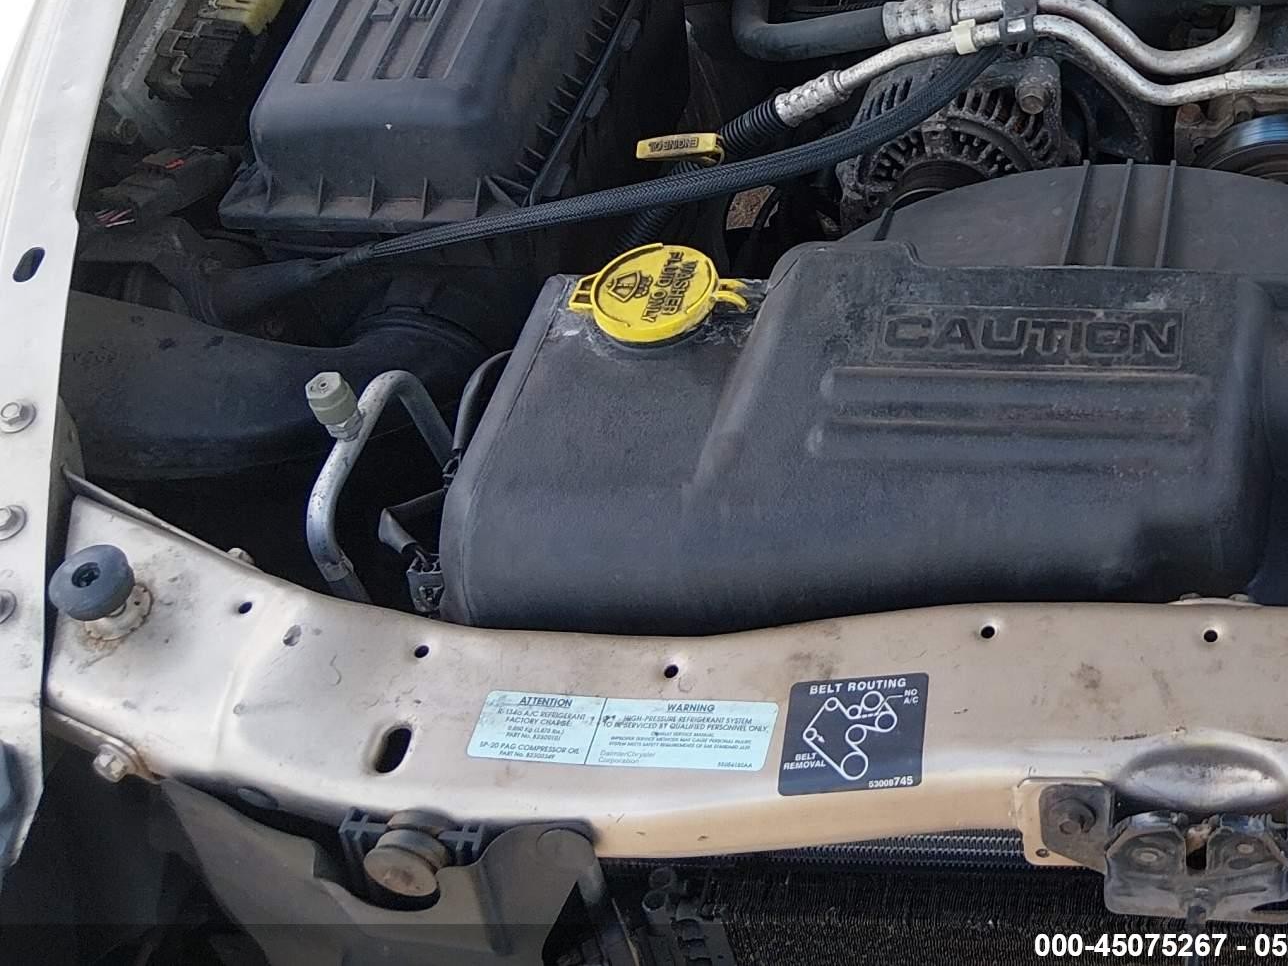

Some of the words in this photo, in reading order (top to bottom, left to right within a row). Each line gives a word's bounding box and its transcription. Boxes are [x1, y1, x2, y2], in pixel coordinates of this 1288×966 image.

[655, 251, 685, 288] FLUID
[661, 259, 699, 316] WASHER
[640, 289, 669, 323] ONLY
[882, 316, 1180, 357] CAUTION
[809, 683, 843, 695] BELT
[847, 677, 908, 693] ROUTING
[904, 688, 919, 697] NO
[519, 696, 574, 708] ATTENTION
[903, 696, 919, 705] A/C
[667, 703, 716, 713] WARNING
[505, 716, 539, 725] FACTORY
[539, 711, 587, 721] REFRIGERANT
[678, 716, 725, 724] REFRIGERANT
[725, 717, 753, 725] SYSTEM
[623, 721, 658, 730] SERVICED
[669, 722, 706, 731] QUALIFIED
[706, 724, 747, 732] PERSONNEL
[500, 742, 517, 751] PAG
[517, 744, 567, 754] COMPRESSOR
[567, 747, 581, 755] OIL
[794, 752, 818, 762] BELT
[783, 759, 826, 771] REMOVAL
